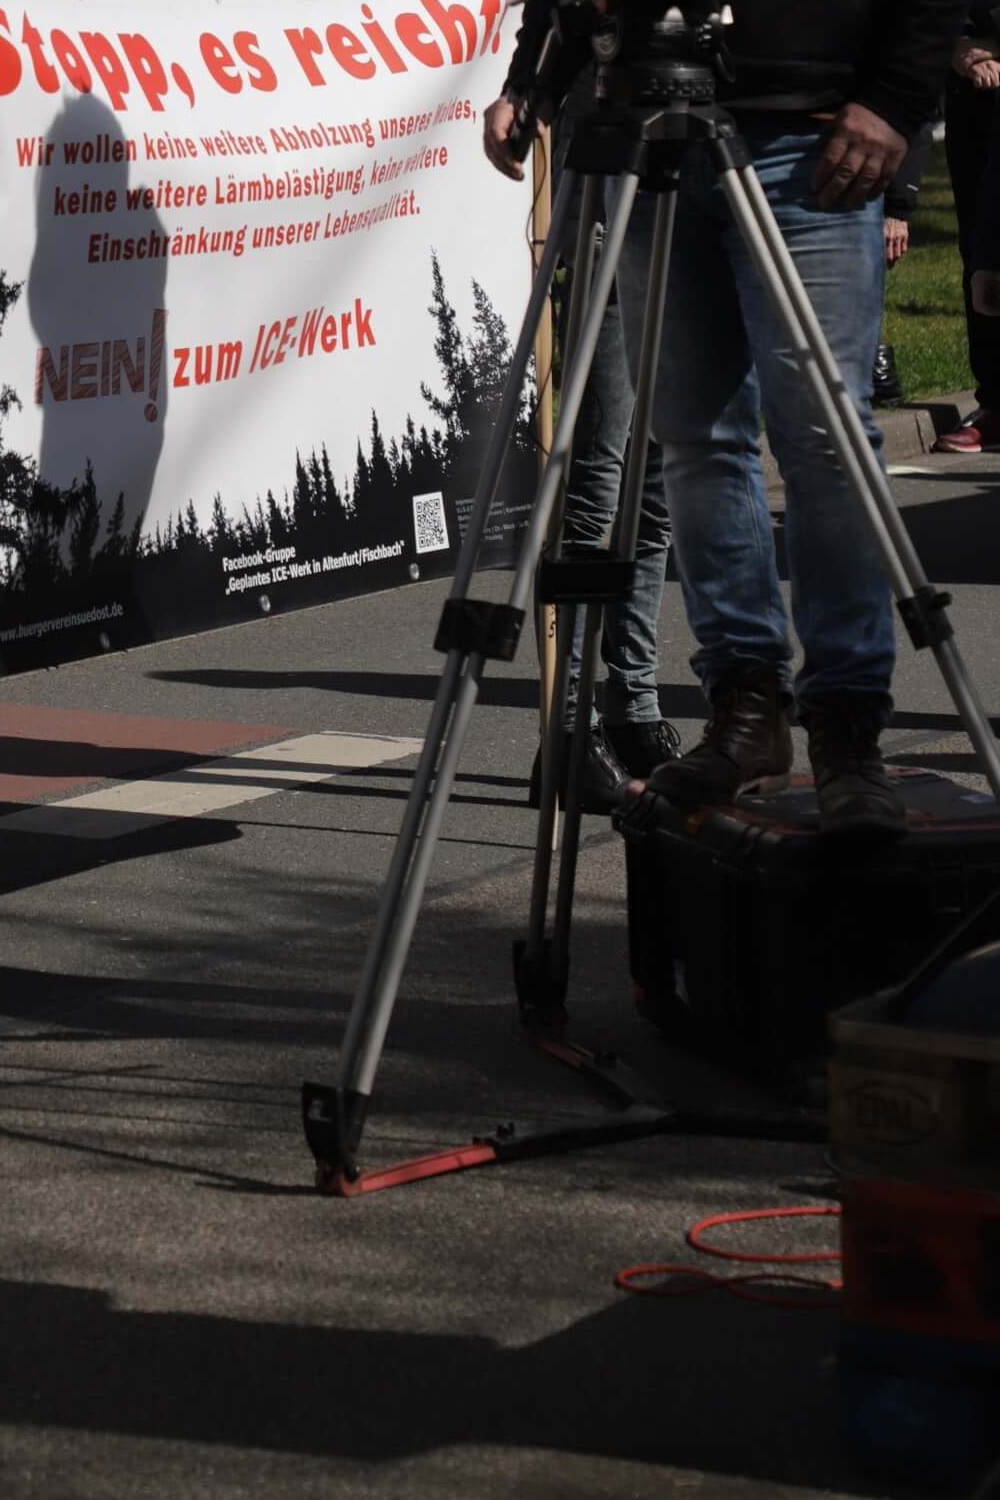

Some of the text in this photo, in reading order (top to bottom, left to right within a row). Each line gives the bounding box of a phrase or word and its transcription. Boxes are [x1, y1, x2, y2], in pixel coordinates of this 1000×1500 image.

[199, 30, 278, 94] es
[16, 137, 54, 167] Wir
[63, 133, 137, 165] wollen
[143, 131, 198, 160] keine
[200, 129, 267, 156] weitere
[269, 118, 375, 153] Abholzung
[379, 111, 432, 141] unseres
[54, 144, 448, 216] keine weitere Lärmbelästigung, keine weitere
[87, 189, 421, 263] Einschränkung unserer Lebensqualität.
[35, 298, 377, 422] NEIN! zum ICE-Werk
[222, 546, 296, 573] Facebook-Gruppe
[272, 561, 312, 583] ICE-Werk
[312, 558, 322, 574] in
